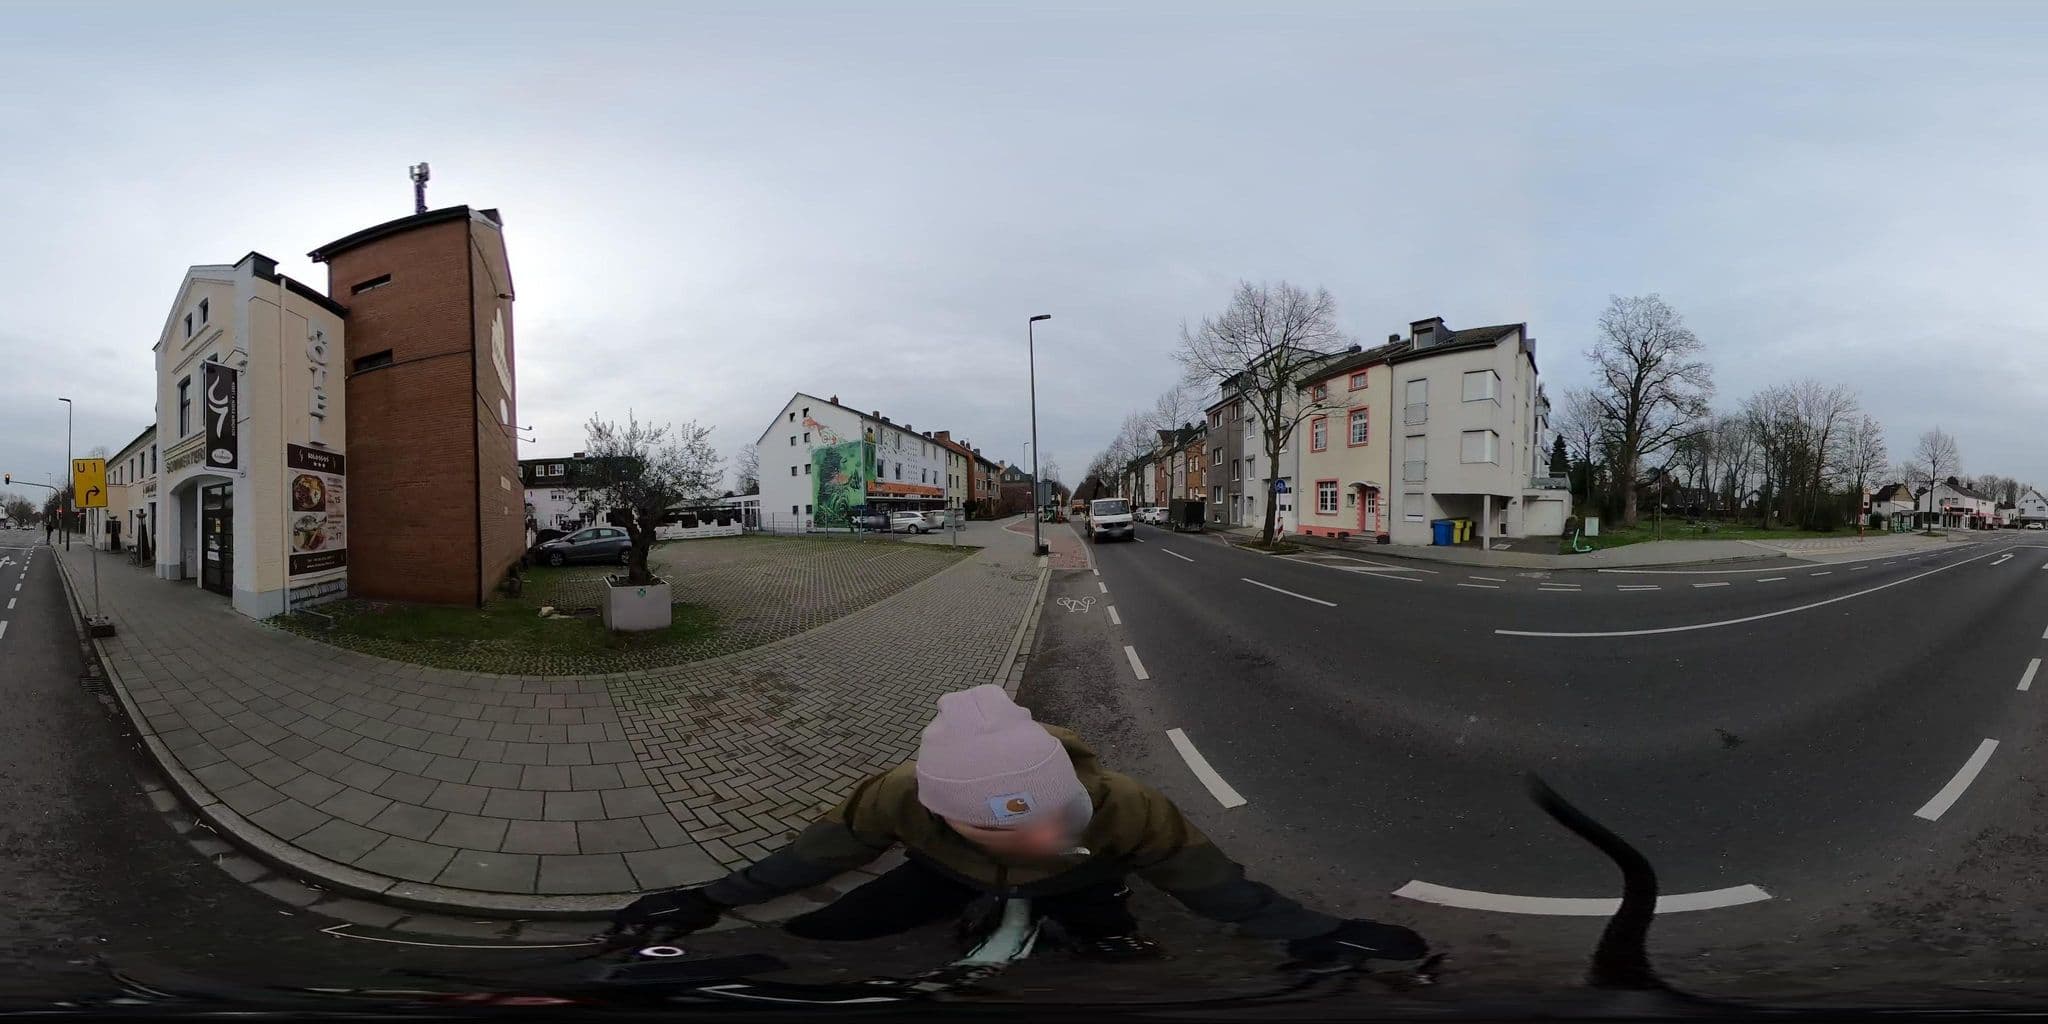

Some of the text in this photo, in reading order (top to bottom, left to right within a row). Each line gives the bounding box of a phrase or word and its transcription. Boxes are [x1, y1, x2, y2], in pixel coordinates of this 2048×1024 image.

[306, 317, 328, 445] HOTEL
[77, 462, 96, 473] U 1
